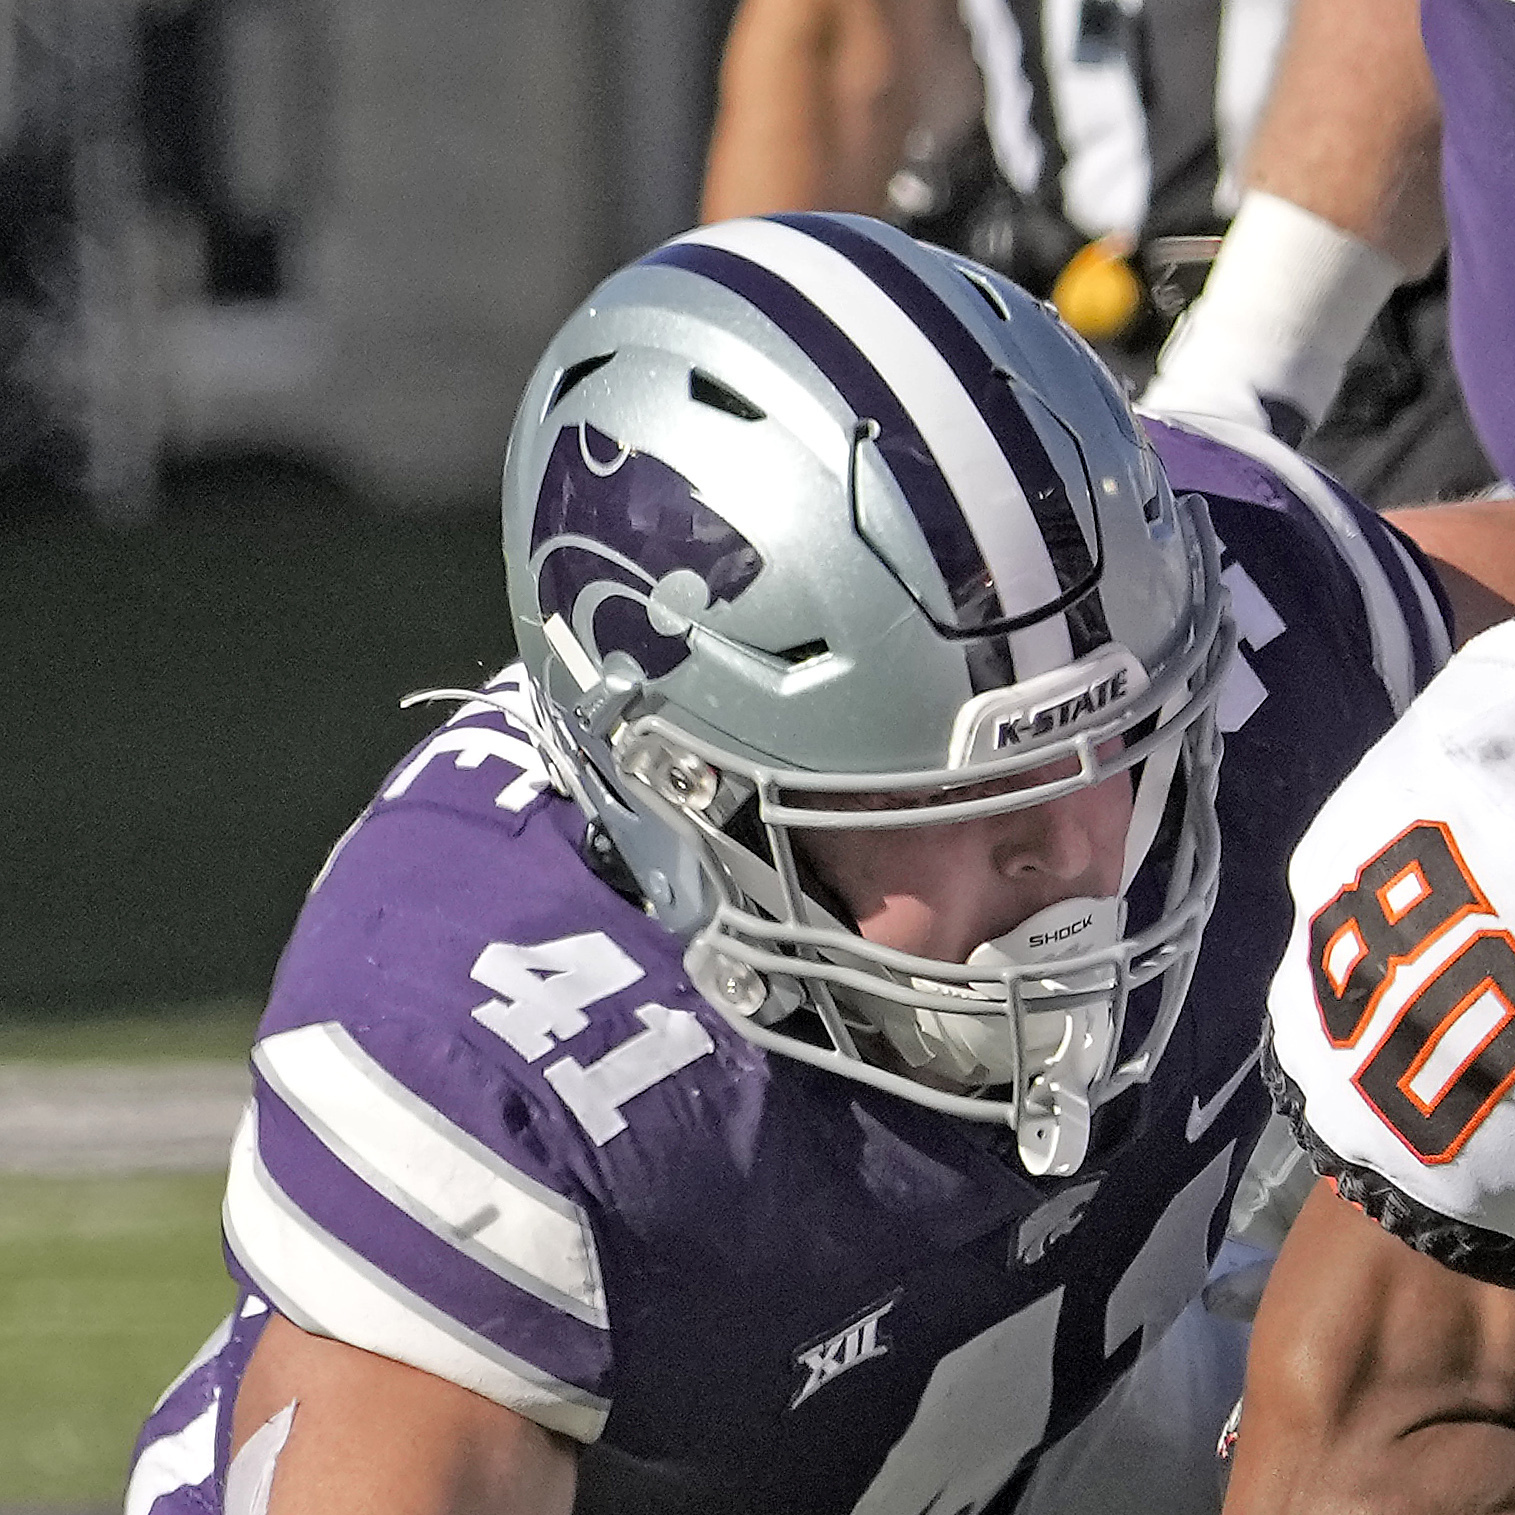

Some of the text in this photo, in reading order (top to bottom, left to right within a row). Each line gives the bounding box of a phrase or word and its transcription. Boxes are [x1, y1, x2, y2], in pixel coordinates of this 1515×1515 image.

[993, 667, 1128, 750] K-STATE
[1028, 913, 1093, 949] SHOCK
[470, 930, 716, 1147] 41
[789, 1300, 894, 1410] XII
